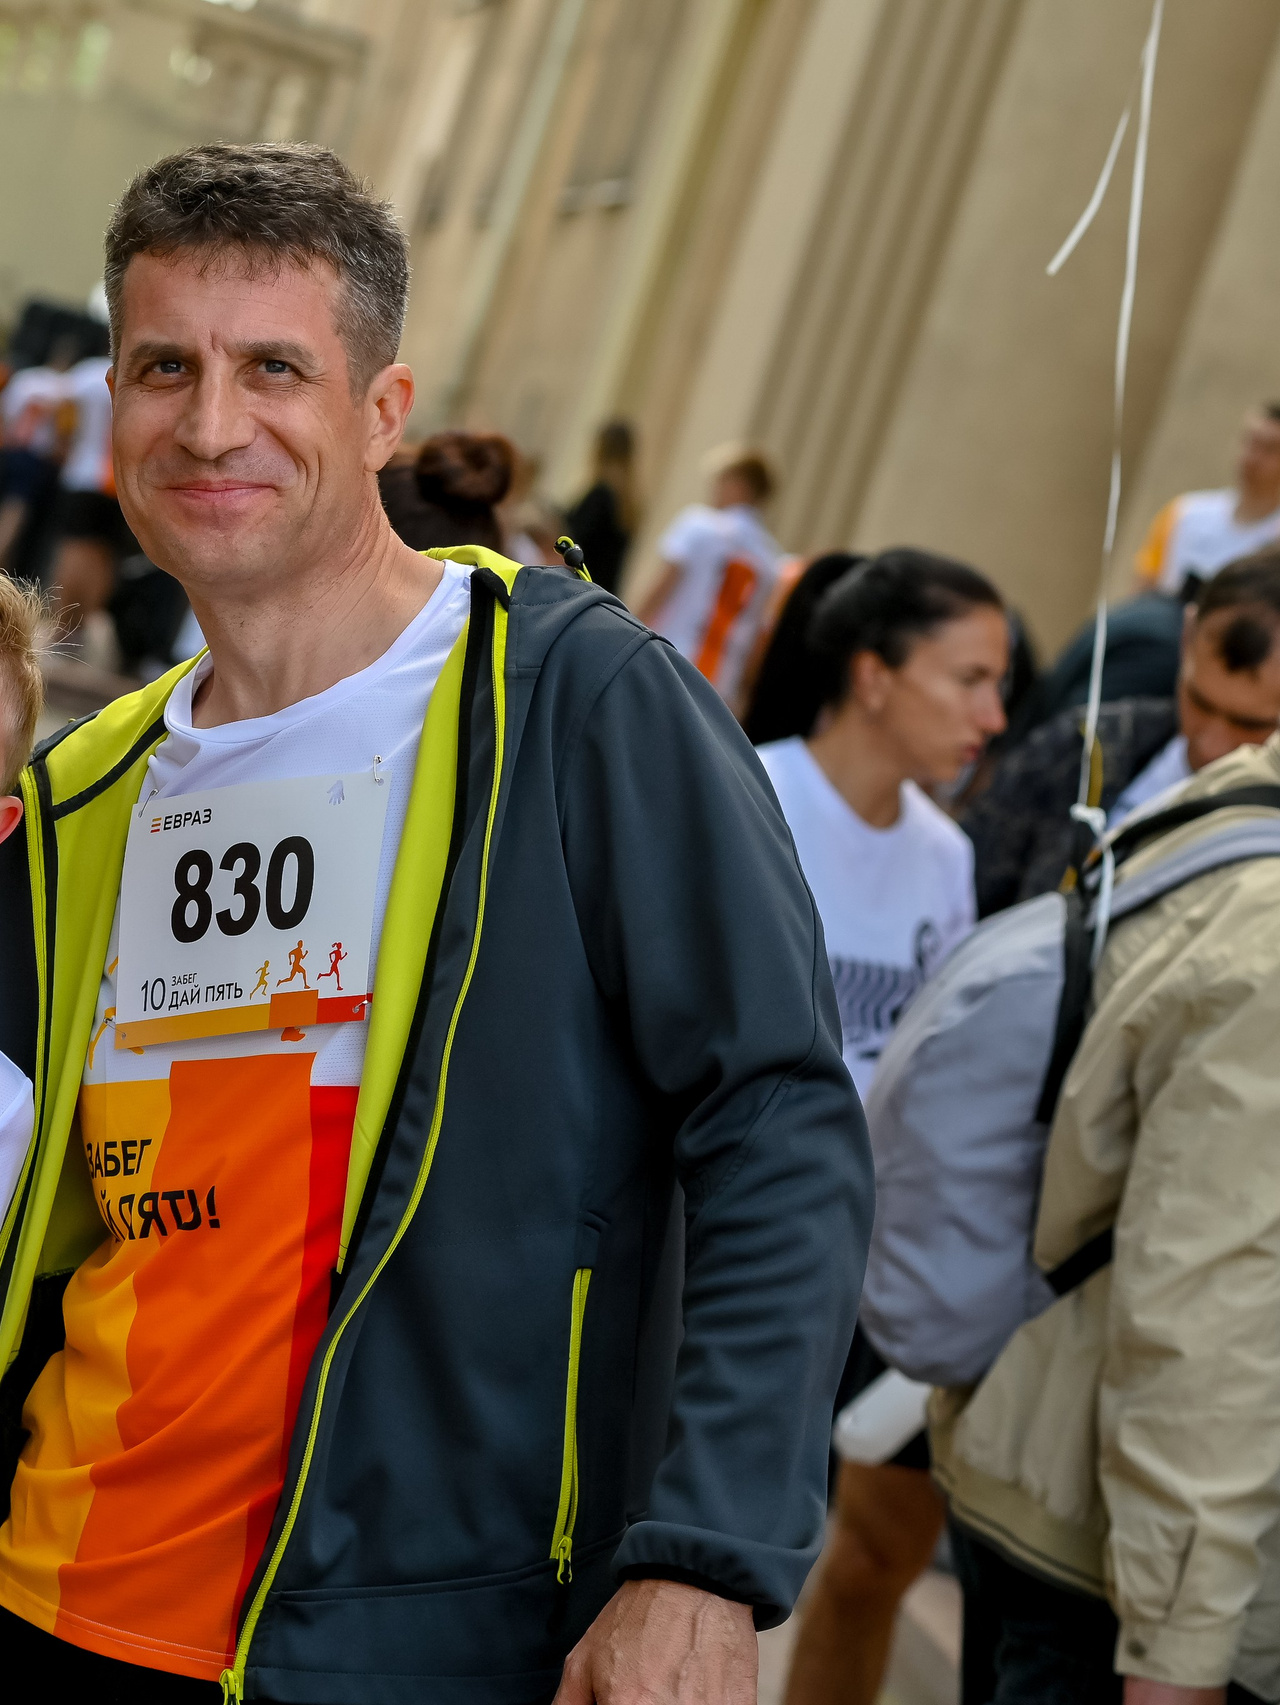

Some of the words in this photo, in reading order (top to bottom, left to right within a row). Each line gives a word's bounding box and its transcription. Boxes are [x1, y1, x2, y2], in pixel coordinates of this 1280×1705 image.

[163, 809, 212, 831] ЕВРАЗ
[171, 836, 314, 943] 830
[140, 977, 166, 1012] 10
[171, 973, 198, 987] ЗАБЕГ
[168, 986, 200, 1011] ДАЙ
[205, 982, 243, 1003] ПЯТЬ
[86, 1138, 152, 1179] ЗАБЕГ
